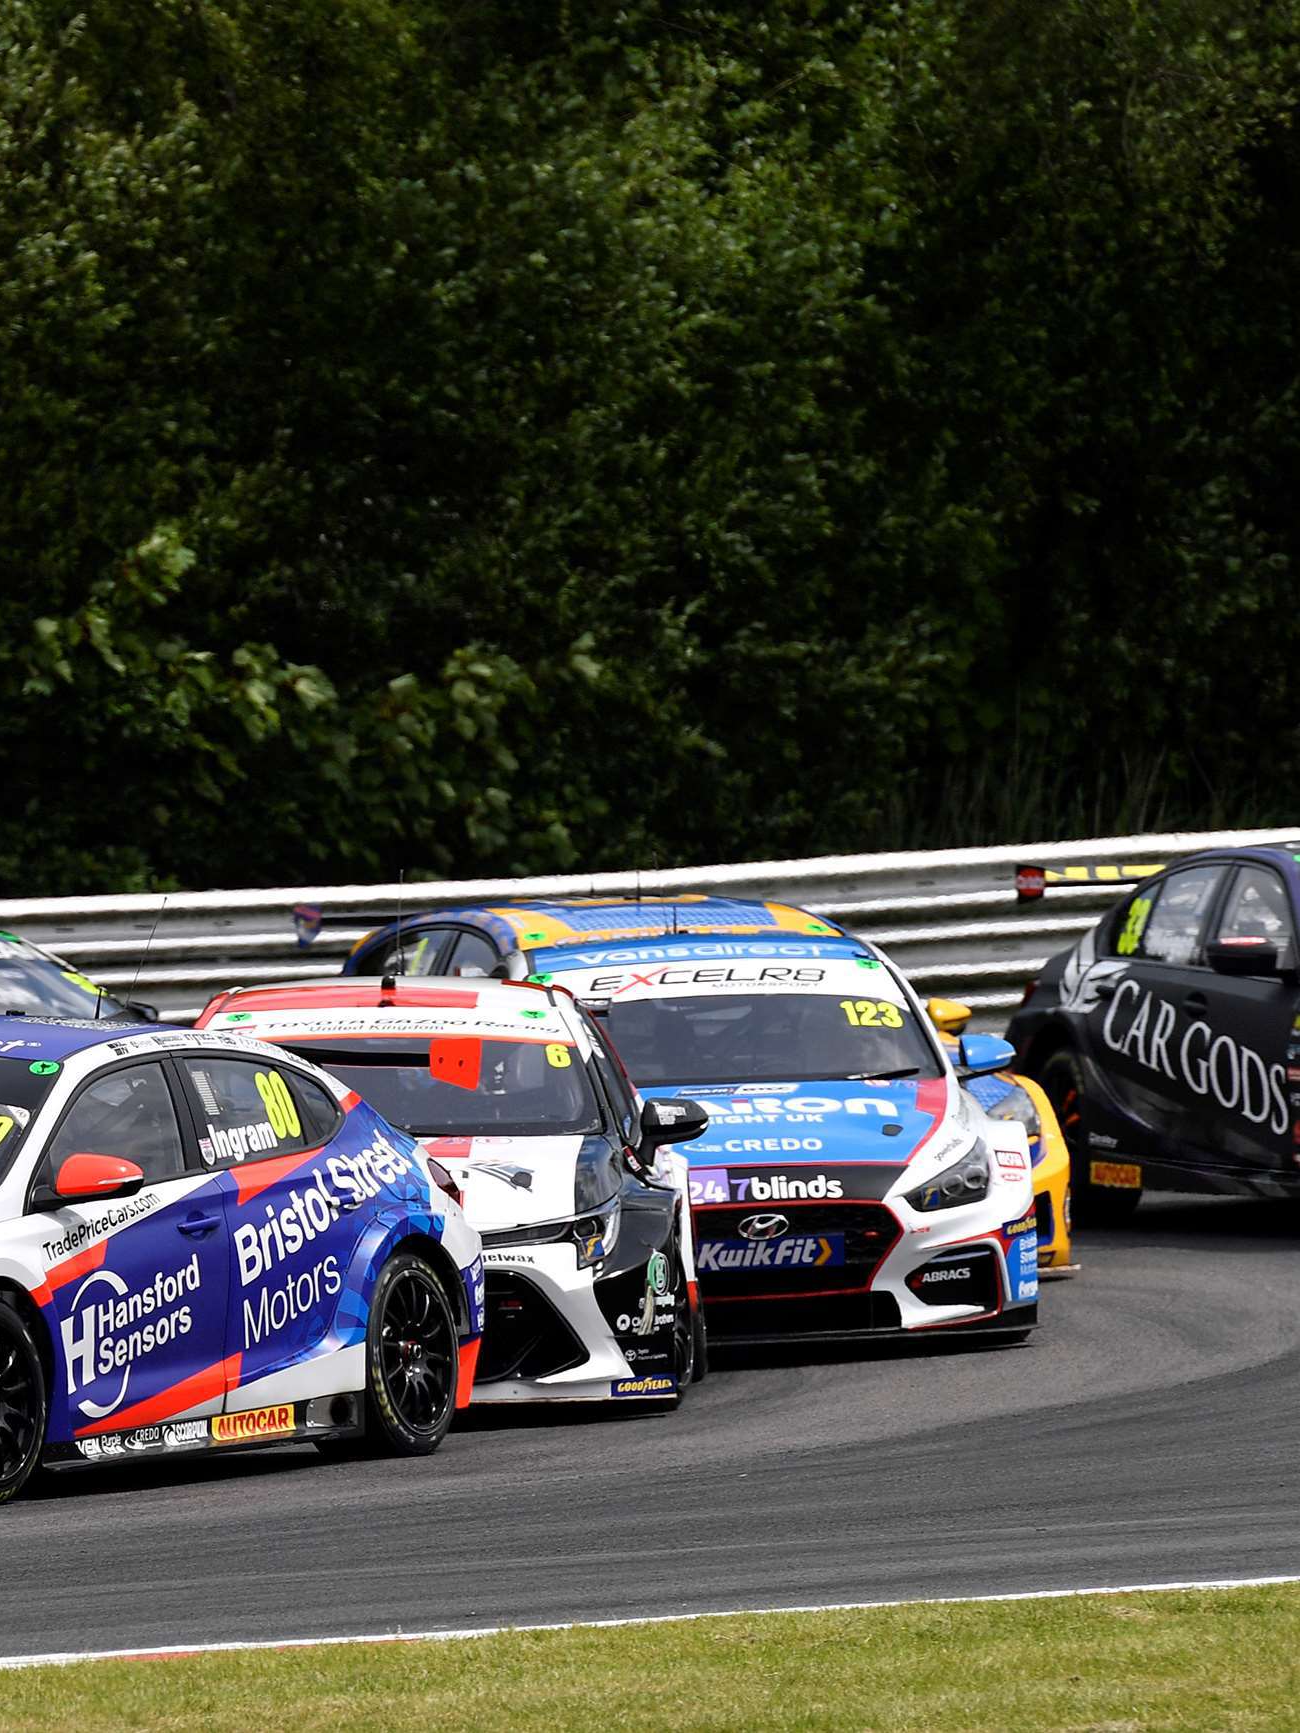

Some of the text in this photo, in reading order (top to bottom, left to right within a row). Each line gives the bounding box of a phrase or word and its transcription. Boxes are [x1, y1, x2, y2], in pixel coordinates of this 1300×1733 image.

[574, 944, 821, 965] vansdirect
[590, 966, 826, 995] EXCELR8
[267, 1019, 366, 1030] TOYOTA
[473, 1020, 561, 1034] Racing
[840, 1000, 904, 1028] 123
[545, 1044, 572, 1068] 6
[1103, 979, 1177, 1080] CAR
[1180, 1021, 1289, 1135] GODS
[254, 1071, 301, 1140] 80
[786, 1112, 824, 1123] UK
[207, 1122, 278, 1162] Ingram
[725, 1138, 823, 1152] CREDO
[233, 1168, 340, 1287] Bristol
[326, 1129, 414, 1200] Street
[43, 1192, 161, 1261] TradePriceCars.com
[921, 1268, 971, 1284] ABRACS
[98, 1253, 201, 1338] Hansford
[243, 1255, 341, 1349] Motors
[60, 1304, 96, 1395] H
[98, 1305, 193, 1374] Sensors
[135, 1426, 160, 1442] CREDO
[175, 1419, 208, 1441] SCORPION
[217, 1407, 289, 1438] AUTOCAR
